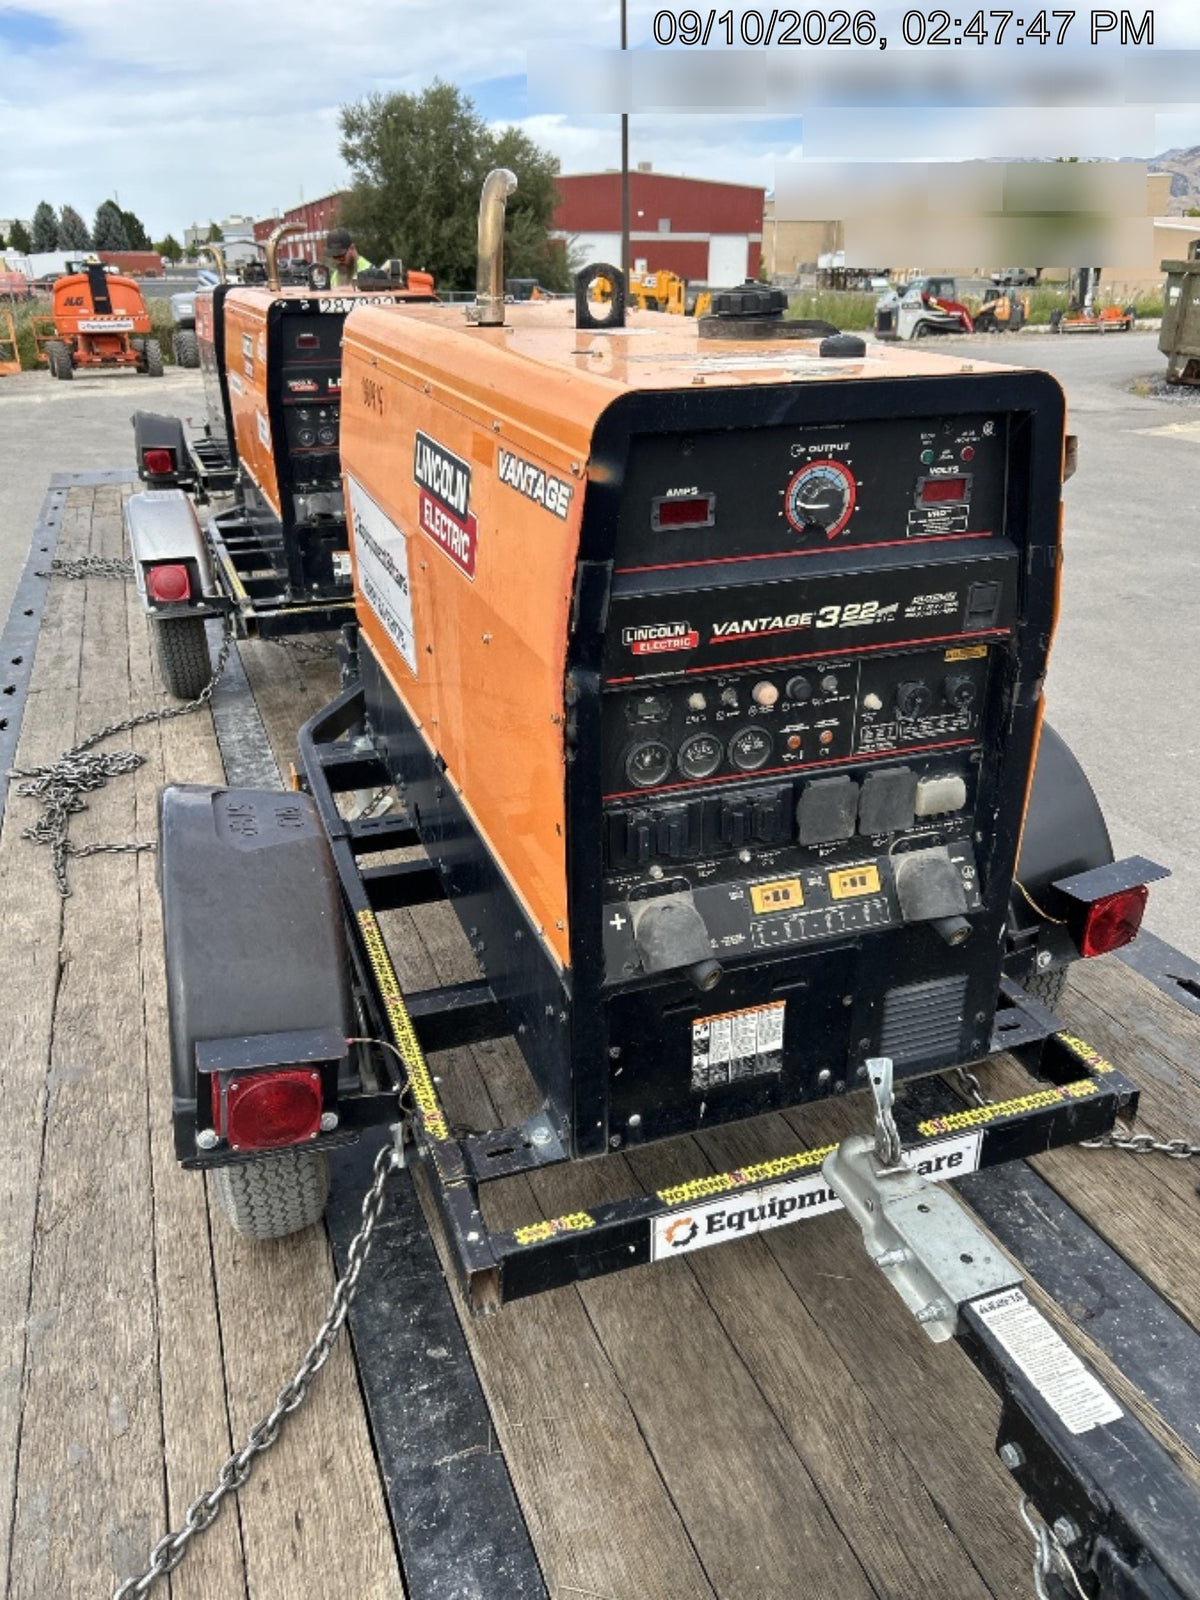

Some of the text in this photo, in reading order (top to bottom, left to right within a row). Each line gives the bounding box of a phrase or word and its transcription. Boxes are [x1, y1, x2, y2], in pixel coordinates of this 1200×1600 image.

[809, 442, 851, 453] OUTPUT
[416, 440, 468, 515] LINCOLN
[930, 465, 959, 474] VOLTS
[498, 448, 572, 519] VANTAGE
[666, 487, 698, 497] AMPS
[424, 497, 470, 564] ELECTRIC
[711, 612, 812, 637] VANTAGE
[815, 600, 880, 629] 322
[626, 624, 686, 642] LINCOLN
[639, 637, 691, 652] ELECTRIC
